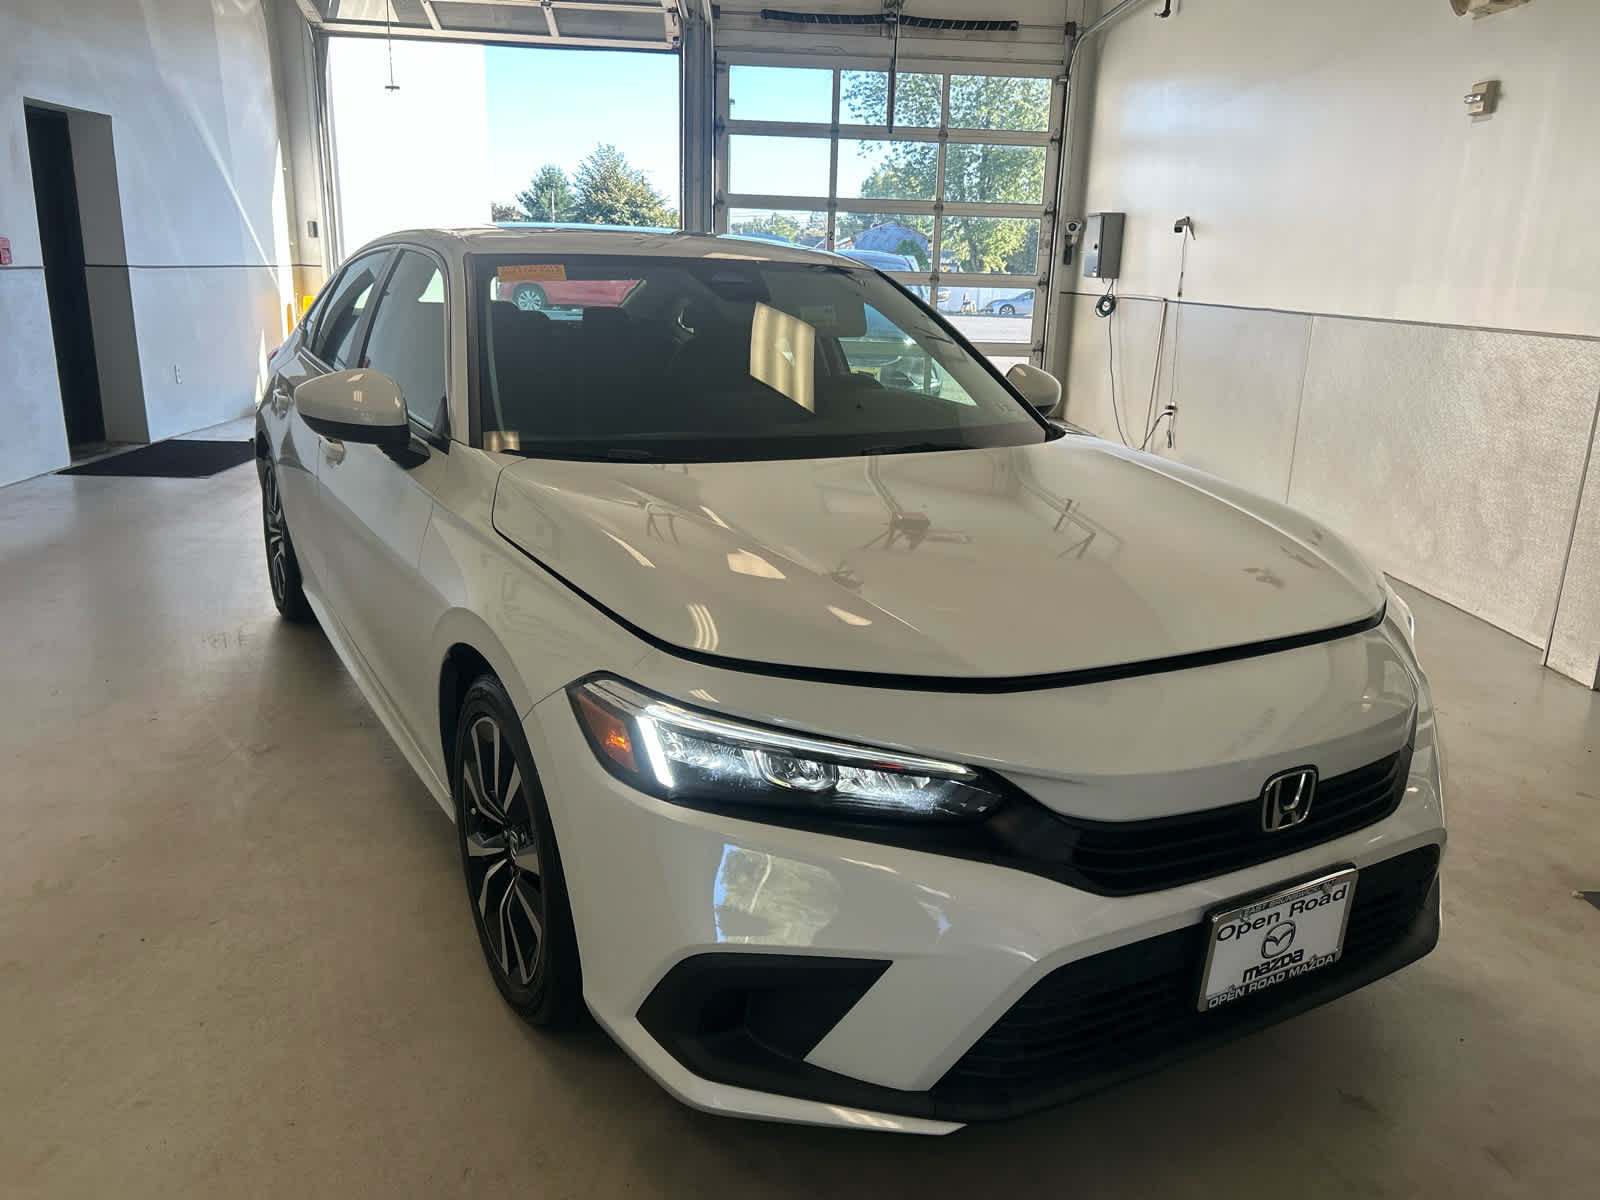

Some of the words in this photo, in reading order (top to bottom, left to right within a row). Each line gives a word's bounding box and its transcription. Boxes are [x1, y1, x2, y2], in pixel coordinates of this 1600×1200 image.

[1216, 912, 1280, 941] Open
[1289, 885, 1347, 917] Road
[1208, 987, 1245, 1008] OPEN
[1249, 972, 1286, 992] ROAD
[1289, 954, 1333, 978] MAZDA
